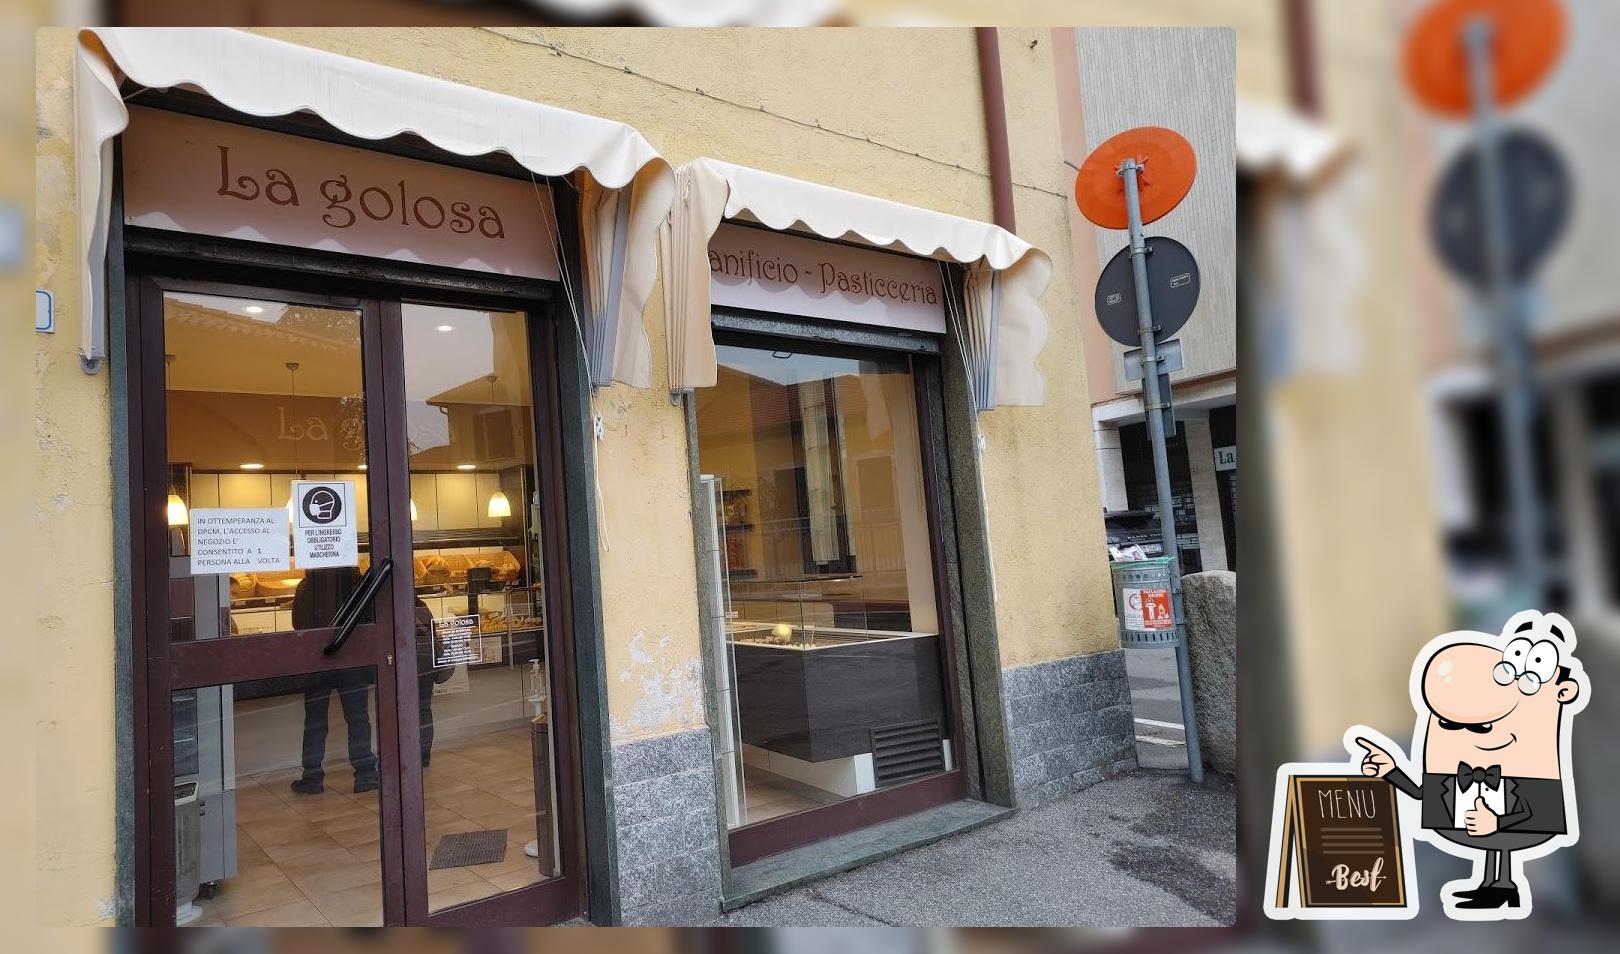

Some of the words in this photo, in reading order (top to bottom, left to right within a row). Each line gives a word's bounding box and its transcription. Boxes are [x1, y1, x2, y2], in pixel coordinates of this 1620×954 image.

[217, 146, 299, 207] La
[320, 174, 505, 239] golosa
[708, 250, 799, 285] anificio
[817, 262, 938, 305] Pasticceria
[197, 517, 206, 525] IN
[207, 517, 265, 525] OTTEMPERANZA
[223, 527, 260, 535] L'ACCESSO
[305, 529, 314, 537] PER
[315, 528, 342, 536] L'INGRESSO
[197, 538, 231, 546] NEGOZIO
[307, 536, 341, 544] OBBLIGATORIO
[314, 543, 335, 551] UTILIZZO
[197, 548, 244, 556] CONSENTITO
[309, 551, 340, 559] MASCHERINA
[197, 559, 232, 567] PERSONA
